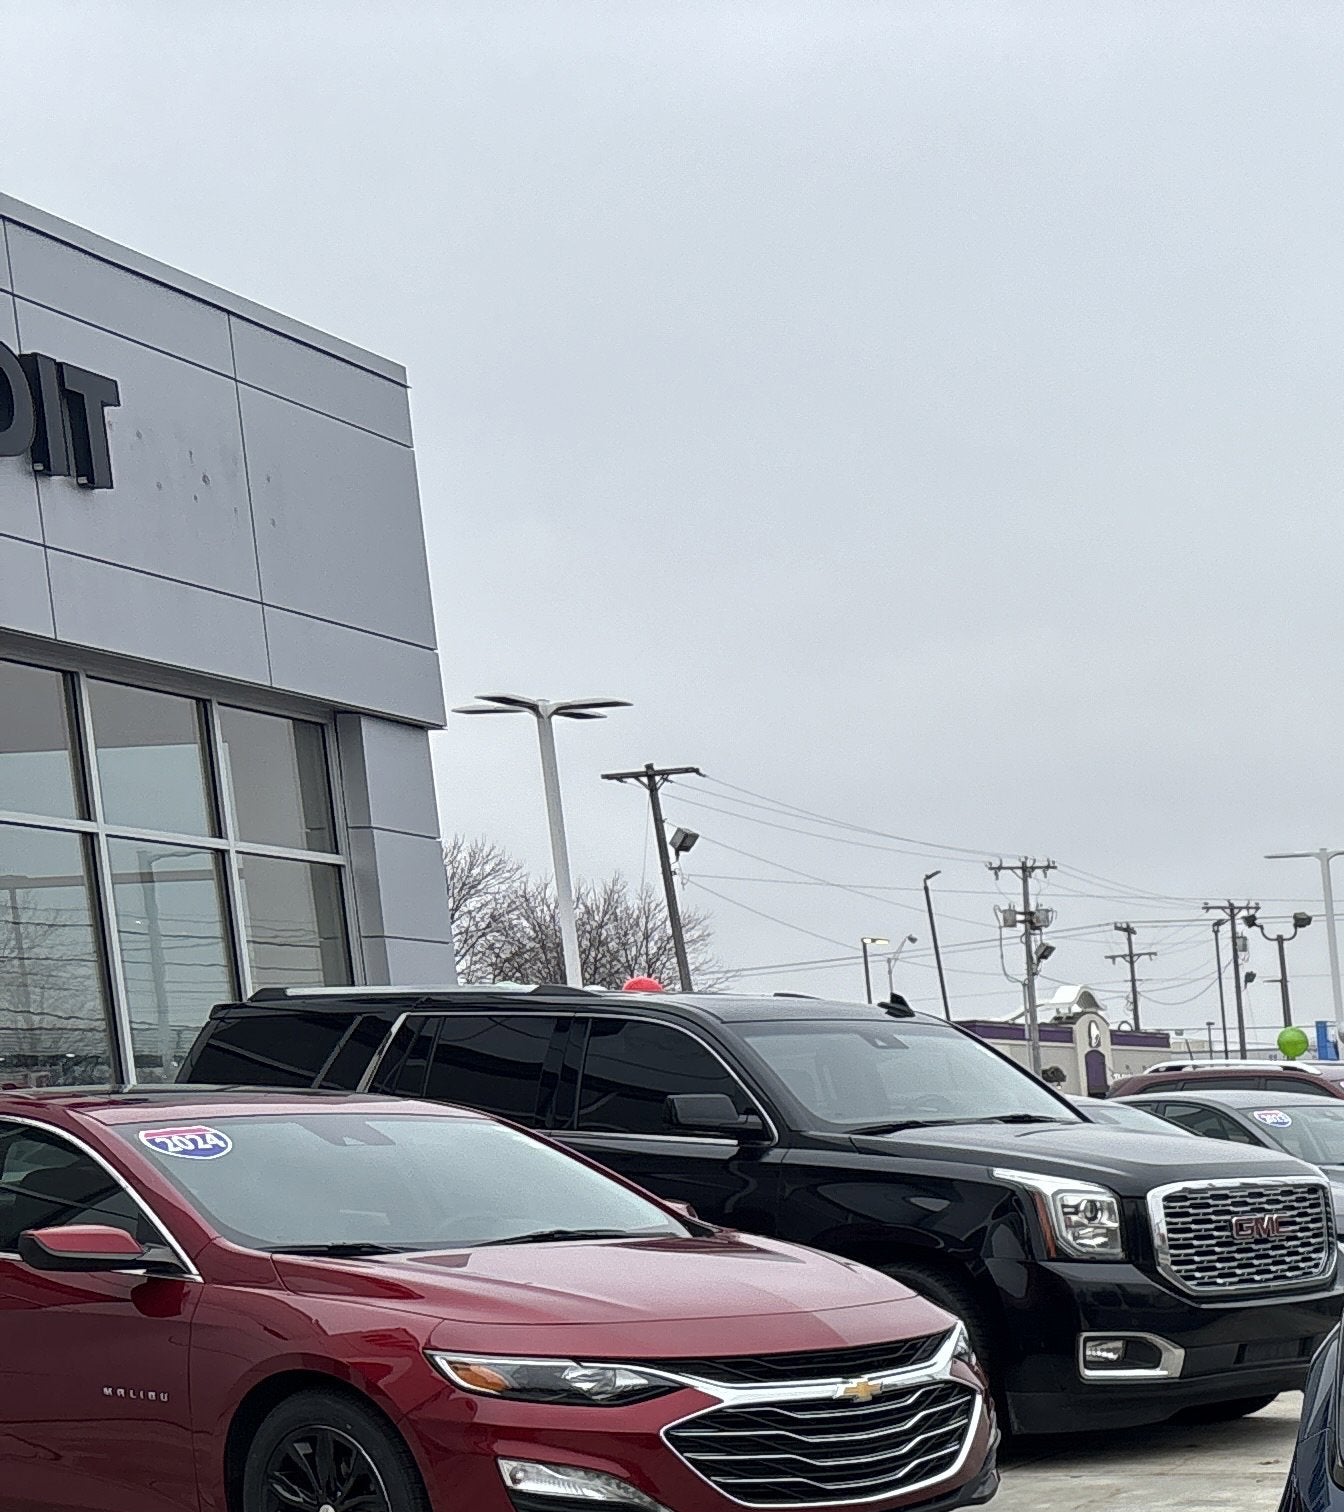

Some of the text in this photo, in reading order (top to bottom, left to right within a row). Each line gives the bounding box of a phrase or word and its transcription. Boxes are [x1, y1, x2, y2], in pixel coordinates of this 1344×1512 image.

[155, 1134, 226, 1152] 2024
[1232, 1214, 1289, 1239] GMC
[103, 1387, 168, 1401] MALIBU
